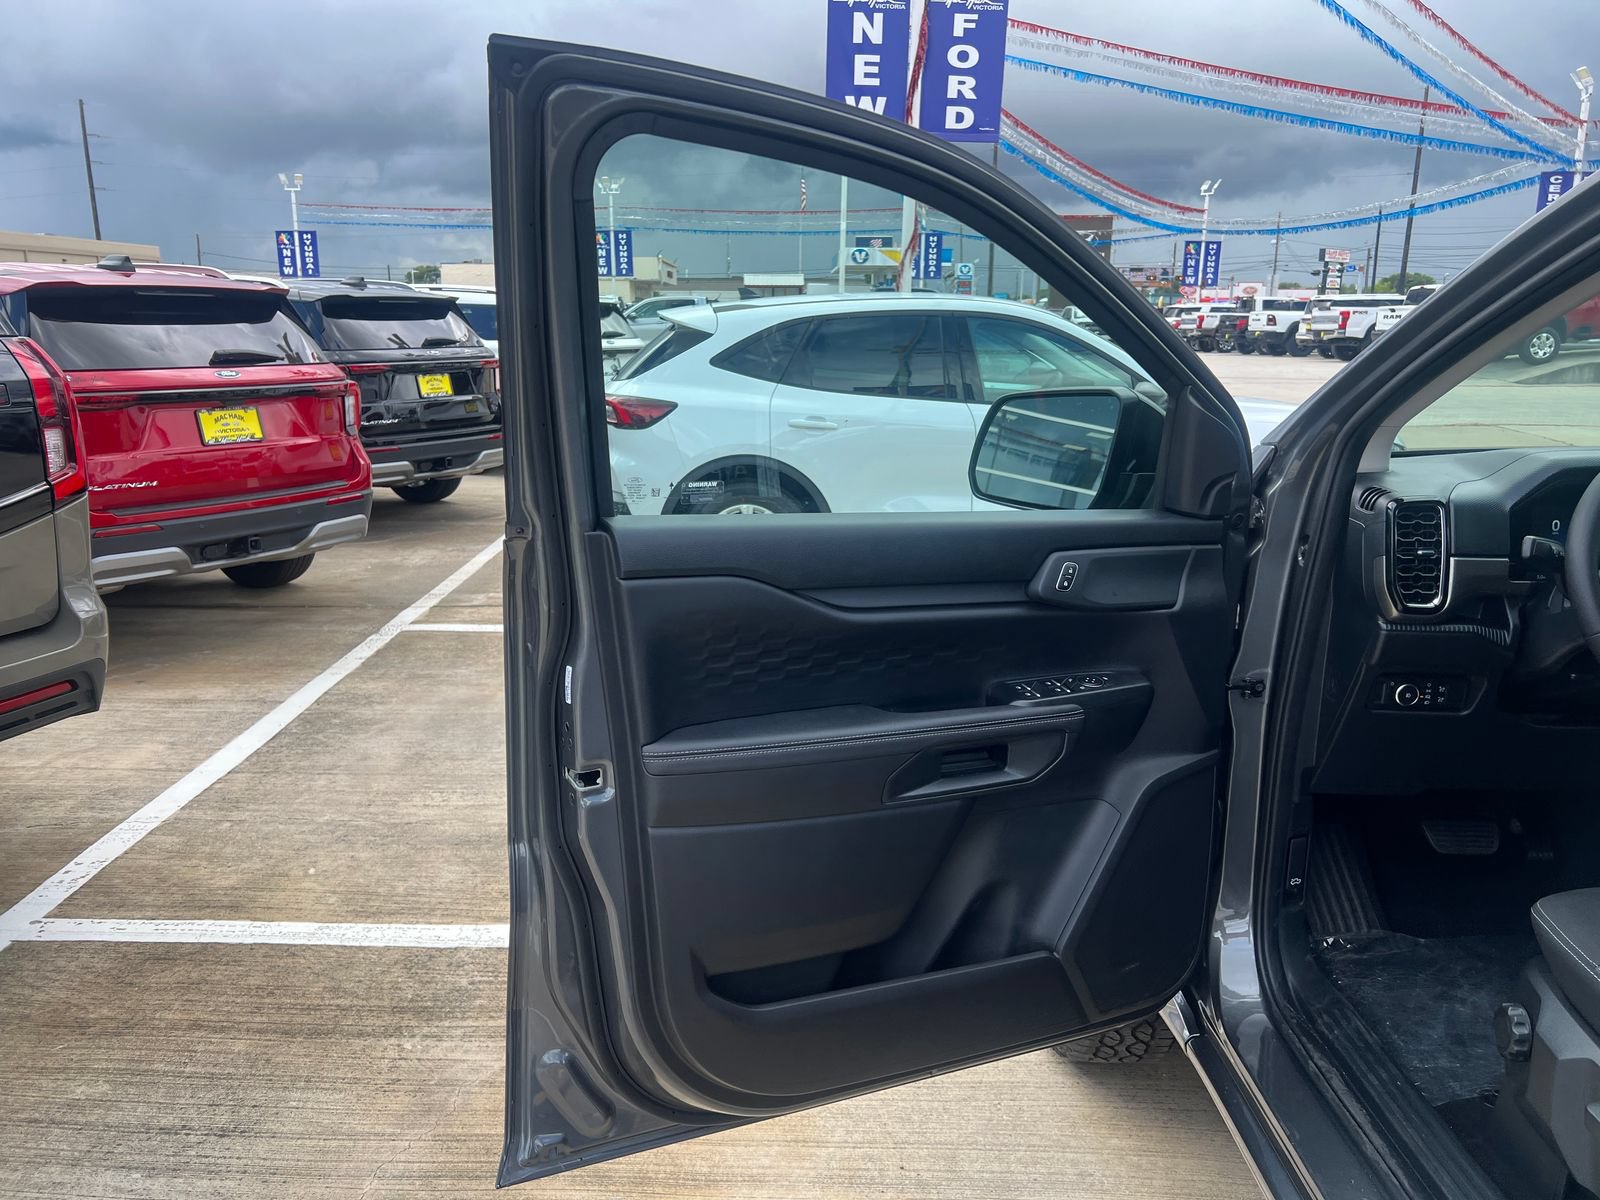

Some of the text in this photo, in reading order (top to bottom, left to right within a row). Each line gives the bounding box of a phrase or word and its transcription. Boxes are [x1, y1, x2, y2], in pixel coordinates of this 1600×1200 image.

[945, 13, 979, 130] FORD
[1546, 175, 1563, 205] CER
[282, 249, 293, 275] NEW
[303, 233, 314, 275] HYUNDAI
[598, 248, 608, 275] NEW
[618, 233, 629, 275] HYUNDAI
[928, 236, 937, 277] HYUNDAI
[1185, 258, 1196, 284] NEW
[1206, 243, 1217, 284] HYUNDAI
[214, 413, 228, 424] MAC
